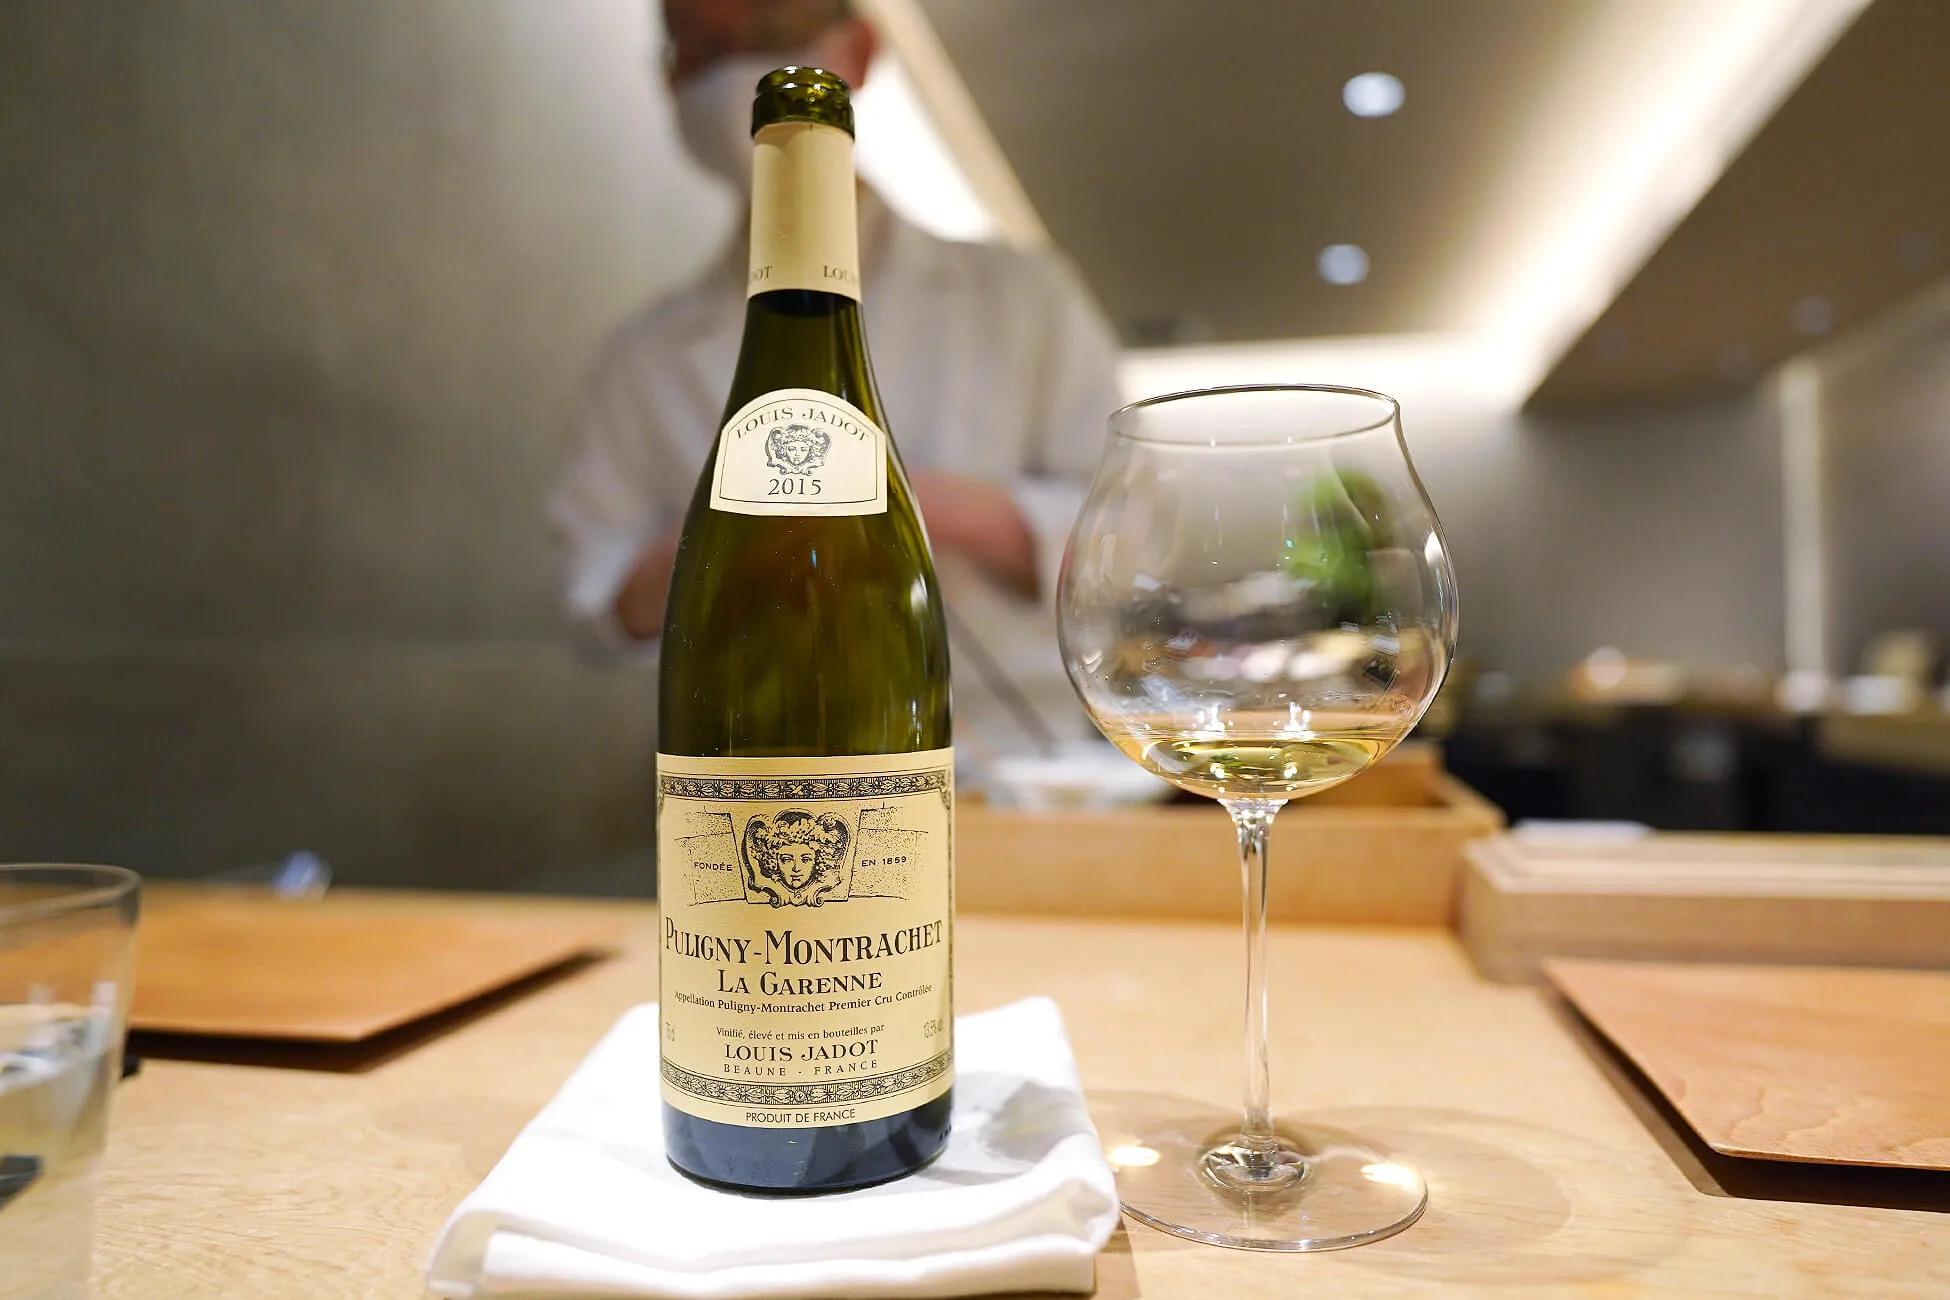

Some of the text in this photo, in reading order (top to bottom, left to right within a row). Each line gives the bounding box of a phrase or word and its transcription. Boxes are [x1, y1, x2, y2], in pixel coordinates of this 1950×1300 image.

[736, 407, 869, 441] LOUIS JADOT
[767, 478, 822, 496] 2015
[694, 856, 907, 871] FONDÉE EN 1859
[674, 984, 933, 1014] Appellation Puligny-Montrachet Premier Cru Contrôlée
[716, 1024, 885, 1041] Vinifié, élevé et mis en bouteilles par
[725, 1039, 879, 1063] LOUIS JADOT
[723, 1063, 786, 1076] BEAUNE
[814, 1060, 878, 1075] FRANCE
[746, 1108, 856, 1124] PRODUIT DE FRANCE
